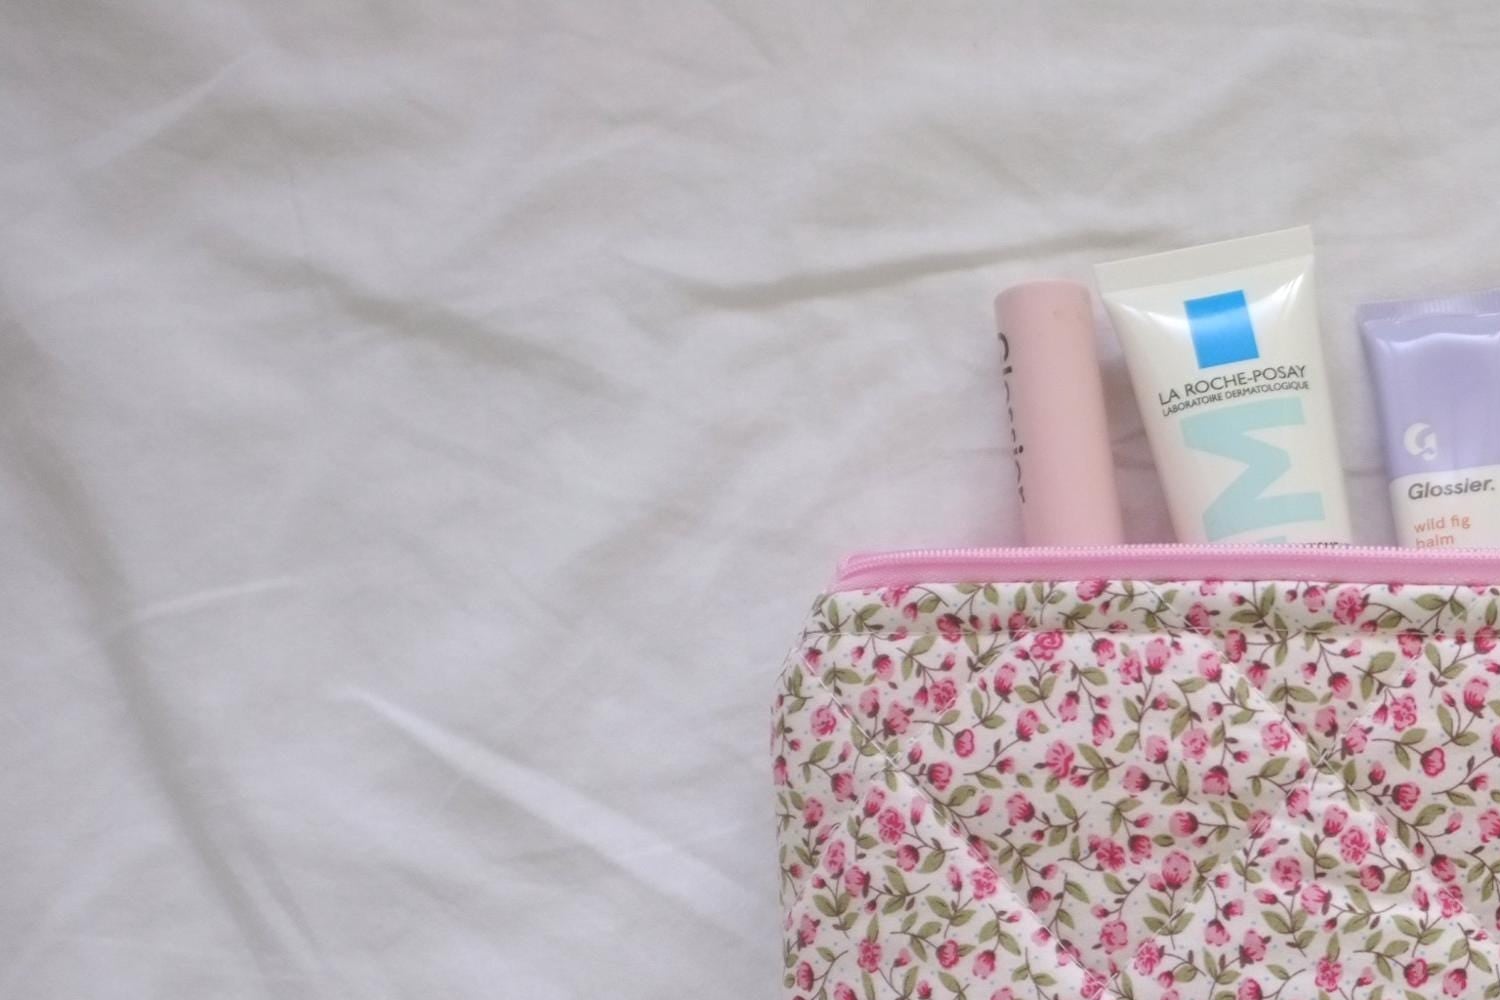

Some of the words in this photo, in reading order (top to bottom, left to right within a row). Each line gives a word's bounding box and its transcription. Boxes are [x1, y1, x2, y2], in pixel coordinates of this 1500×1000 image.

[1158, 388, 1181, 406] LA
[1184, 364, 1307, 397] ROCHE-POSAY
[1161, 392, 1224, 417] LABORATOIRE
[1224, 380, 1310, 401] DERMATOLOGIQUE
[1407, 478, 1495, 500] Glossier.
[1413, 516, 1446, 533] wild
[1450, 514, 1472, 530] fig
[1415, 534, 1455, 550] balm
